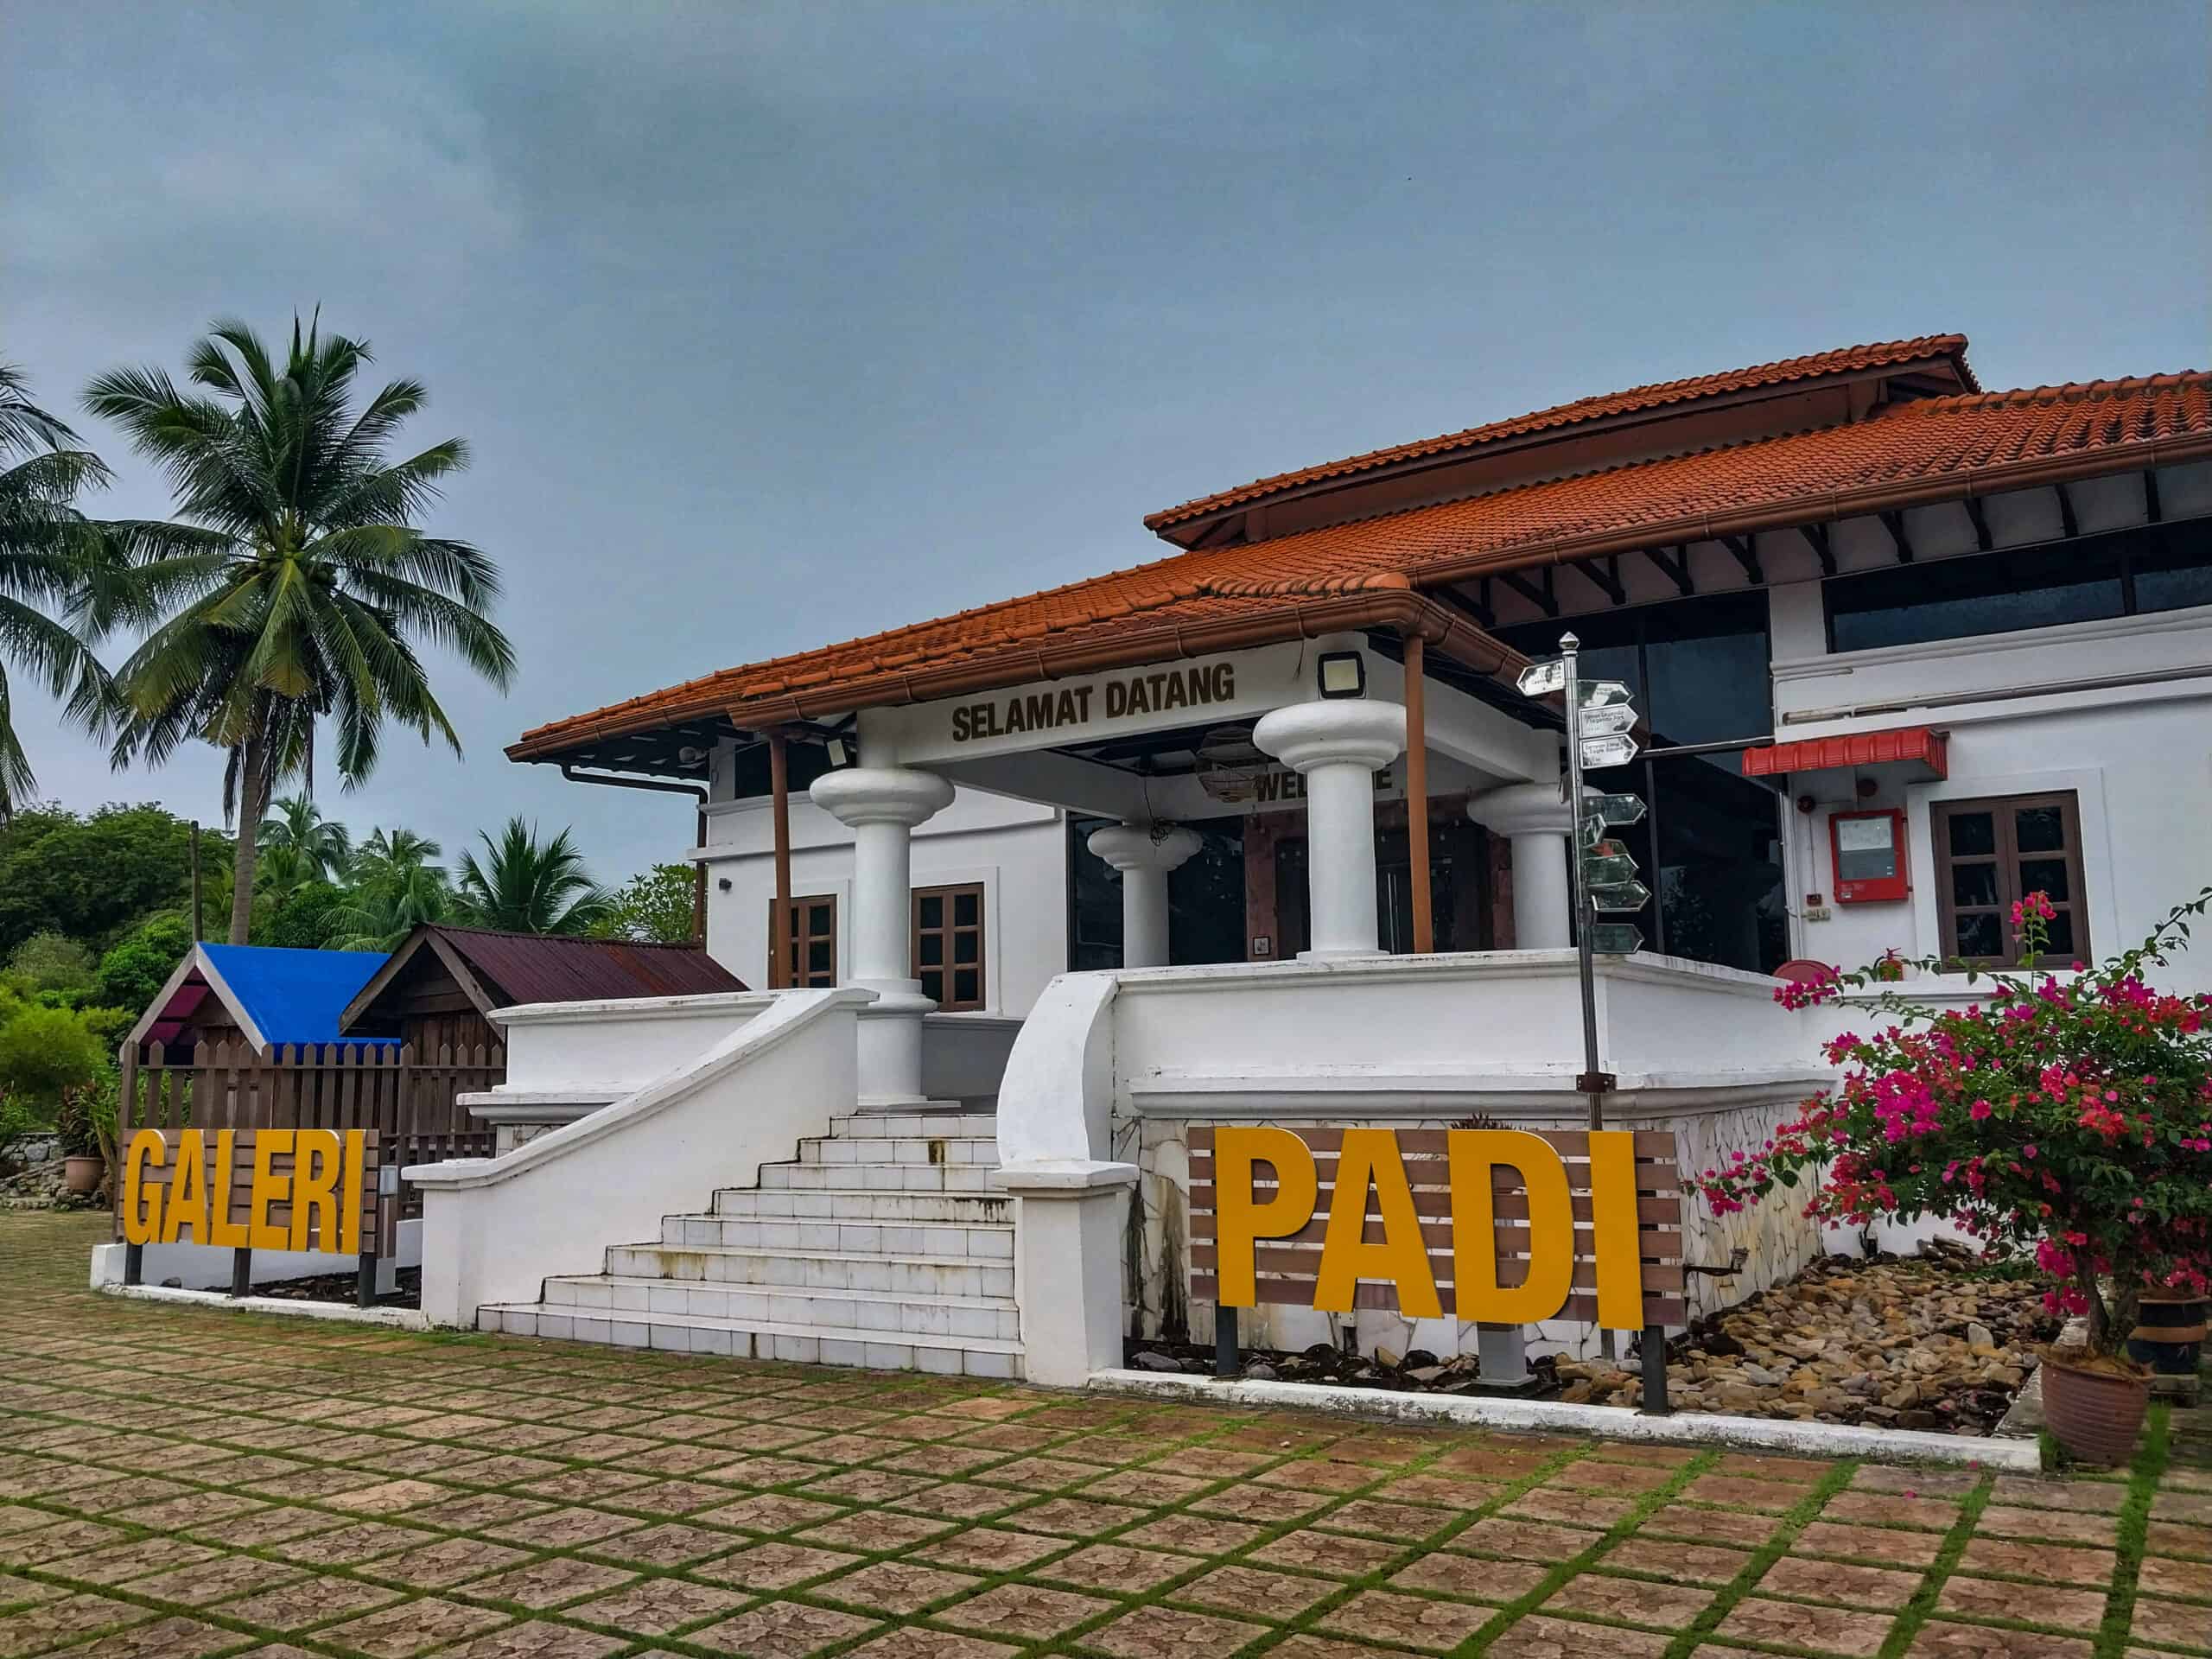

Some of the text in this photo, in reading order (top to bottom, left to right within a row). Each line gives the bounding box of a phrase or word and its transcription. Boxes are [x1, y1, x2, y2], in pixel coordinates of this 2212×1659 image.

[952, 664, 1235, 742] SELAMAT DATANG
[1257, 769, 1393, 802] WELE
[124, 1128, 367, 1255] GALERI
[1215, 1127, 1644, 1332] PADI
